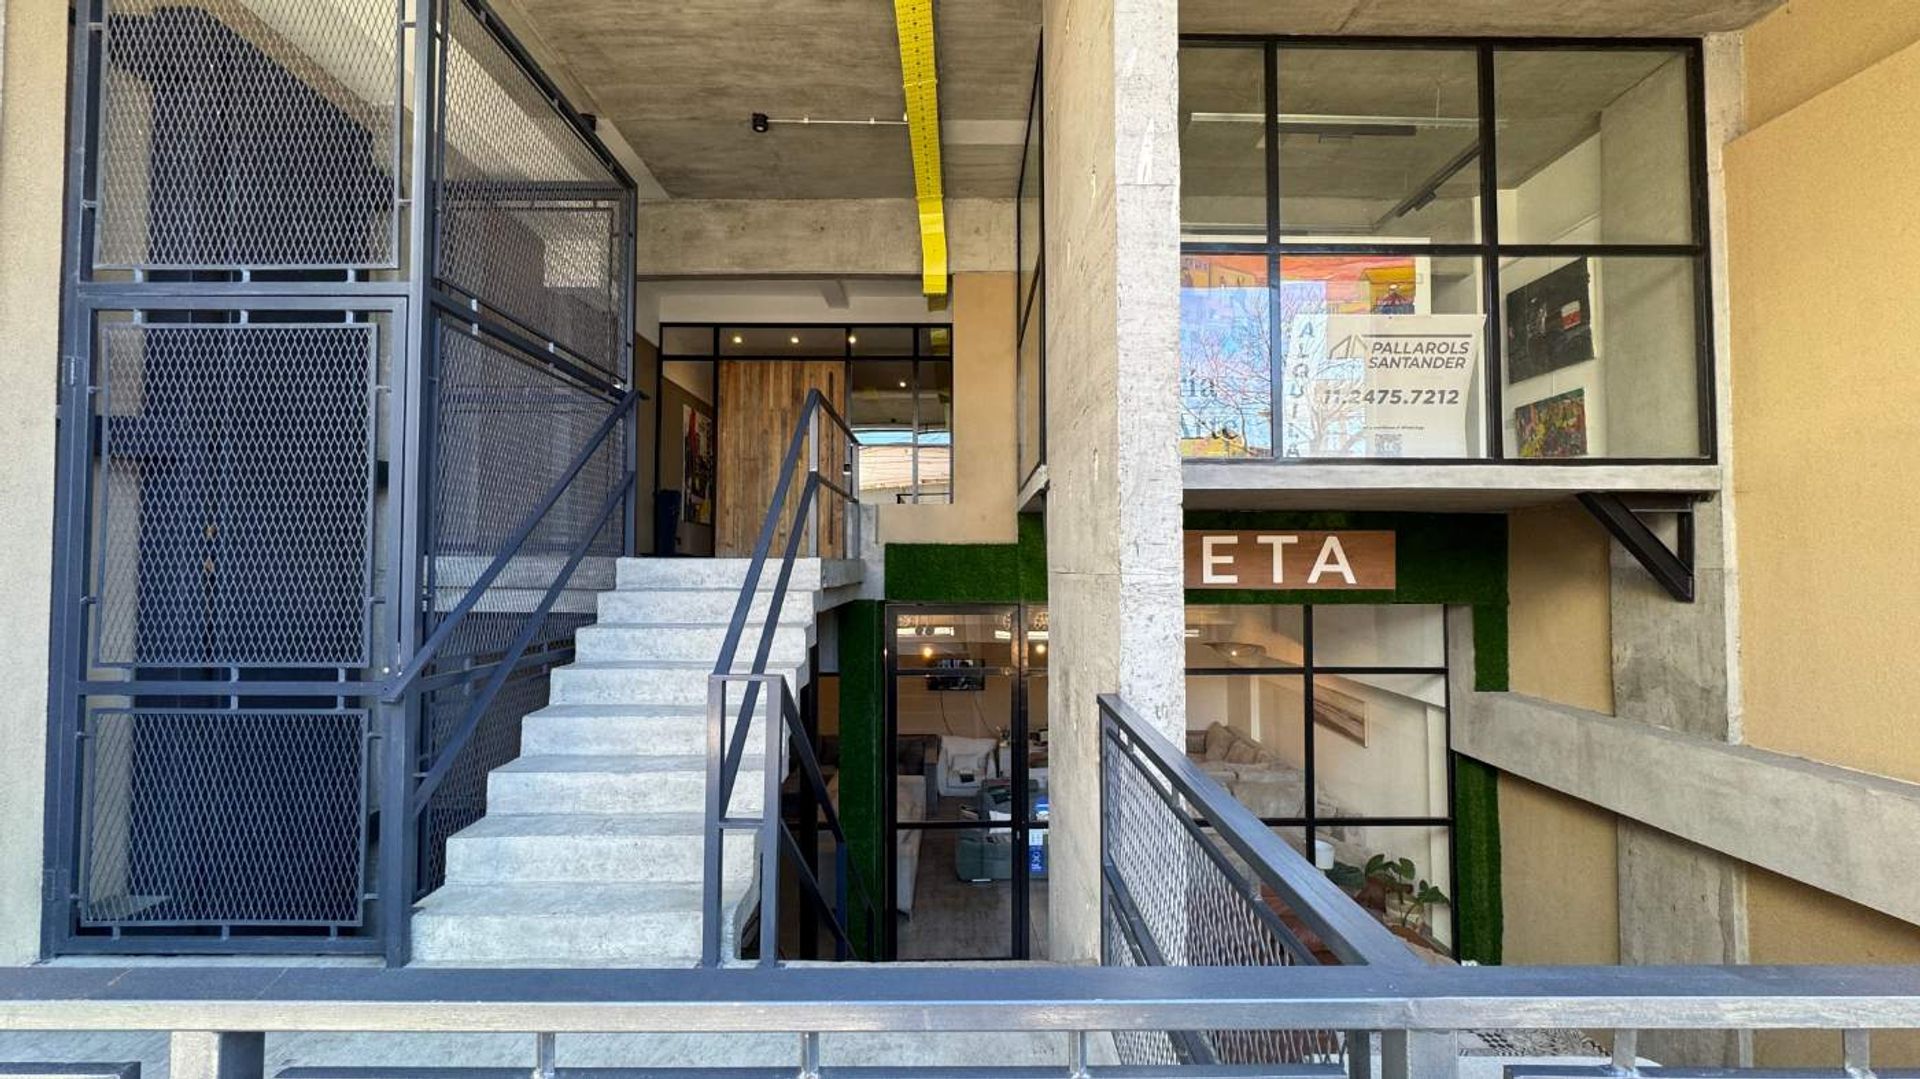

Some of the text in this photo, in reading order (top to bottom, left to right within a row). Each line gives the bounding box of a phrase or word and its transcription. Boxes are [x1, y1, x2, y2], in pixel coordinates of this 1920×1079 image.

[1371, 341, 1470, 354] PALLAROLS
[1368, 356, 1467, 369] SANTANDER
[1324, 389, 1459, 404] 11.2475.7212
[1202, 535, 1358, 584] ETA
